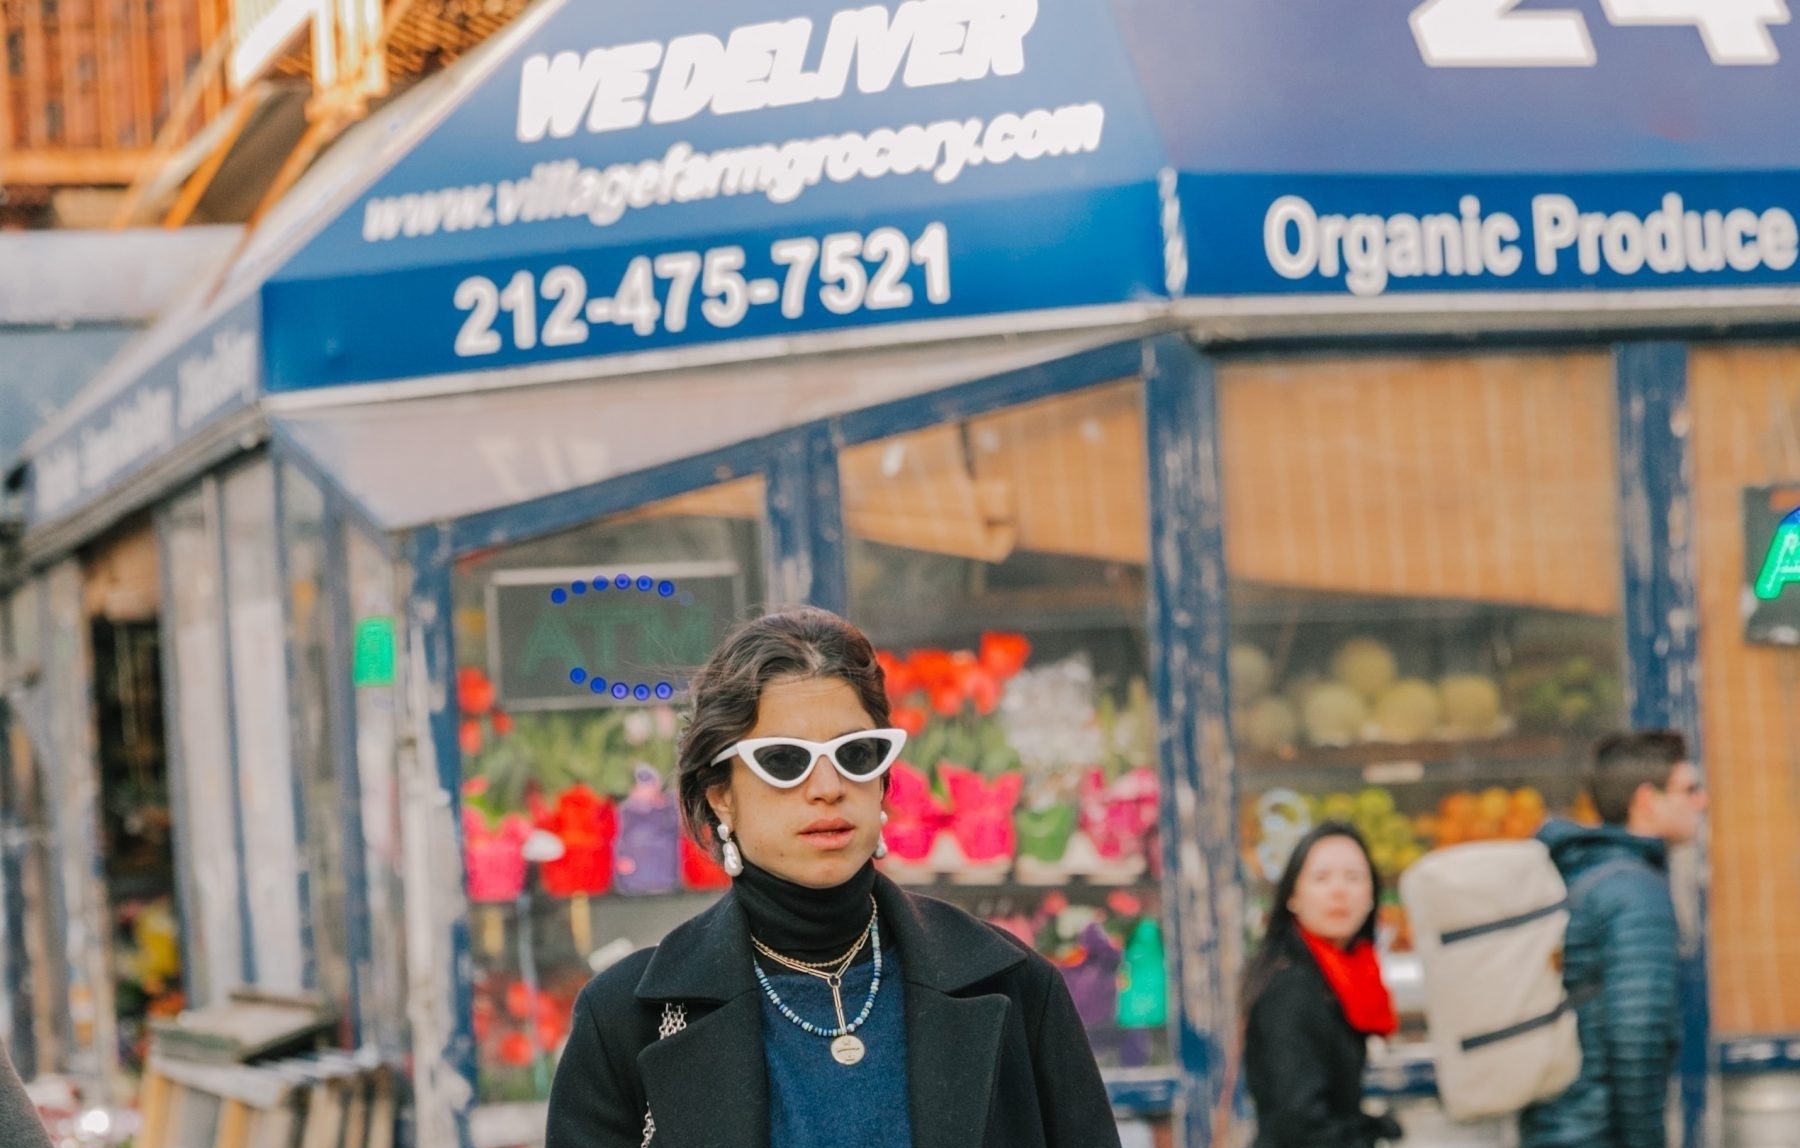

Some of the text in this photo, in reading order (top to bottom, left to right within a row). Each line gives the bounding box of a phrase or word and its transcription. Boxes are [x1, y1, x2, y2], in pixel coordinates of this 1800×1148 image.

[648, 0, 1038, 124] DELIVER
[452, 222, 952, 358] 212-475-7521
[1264, 192, 1800, 296] Organic Produce
[516, 603, 713, 678] ATM
